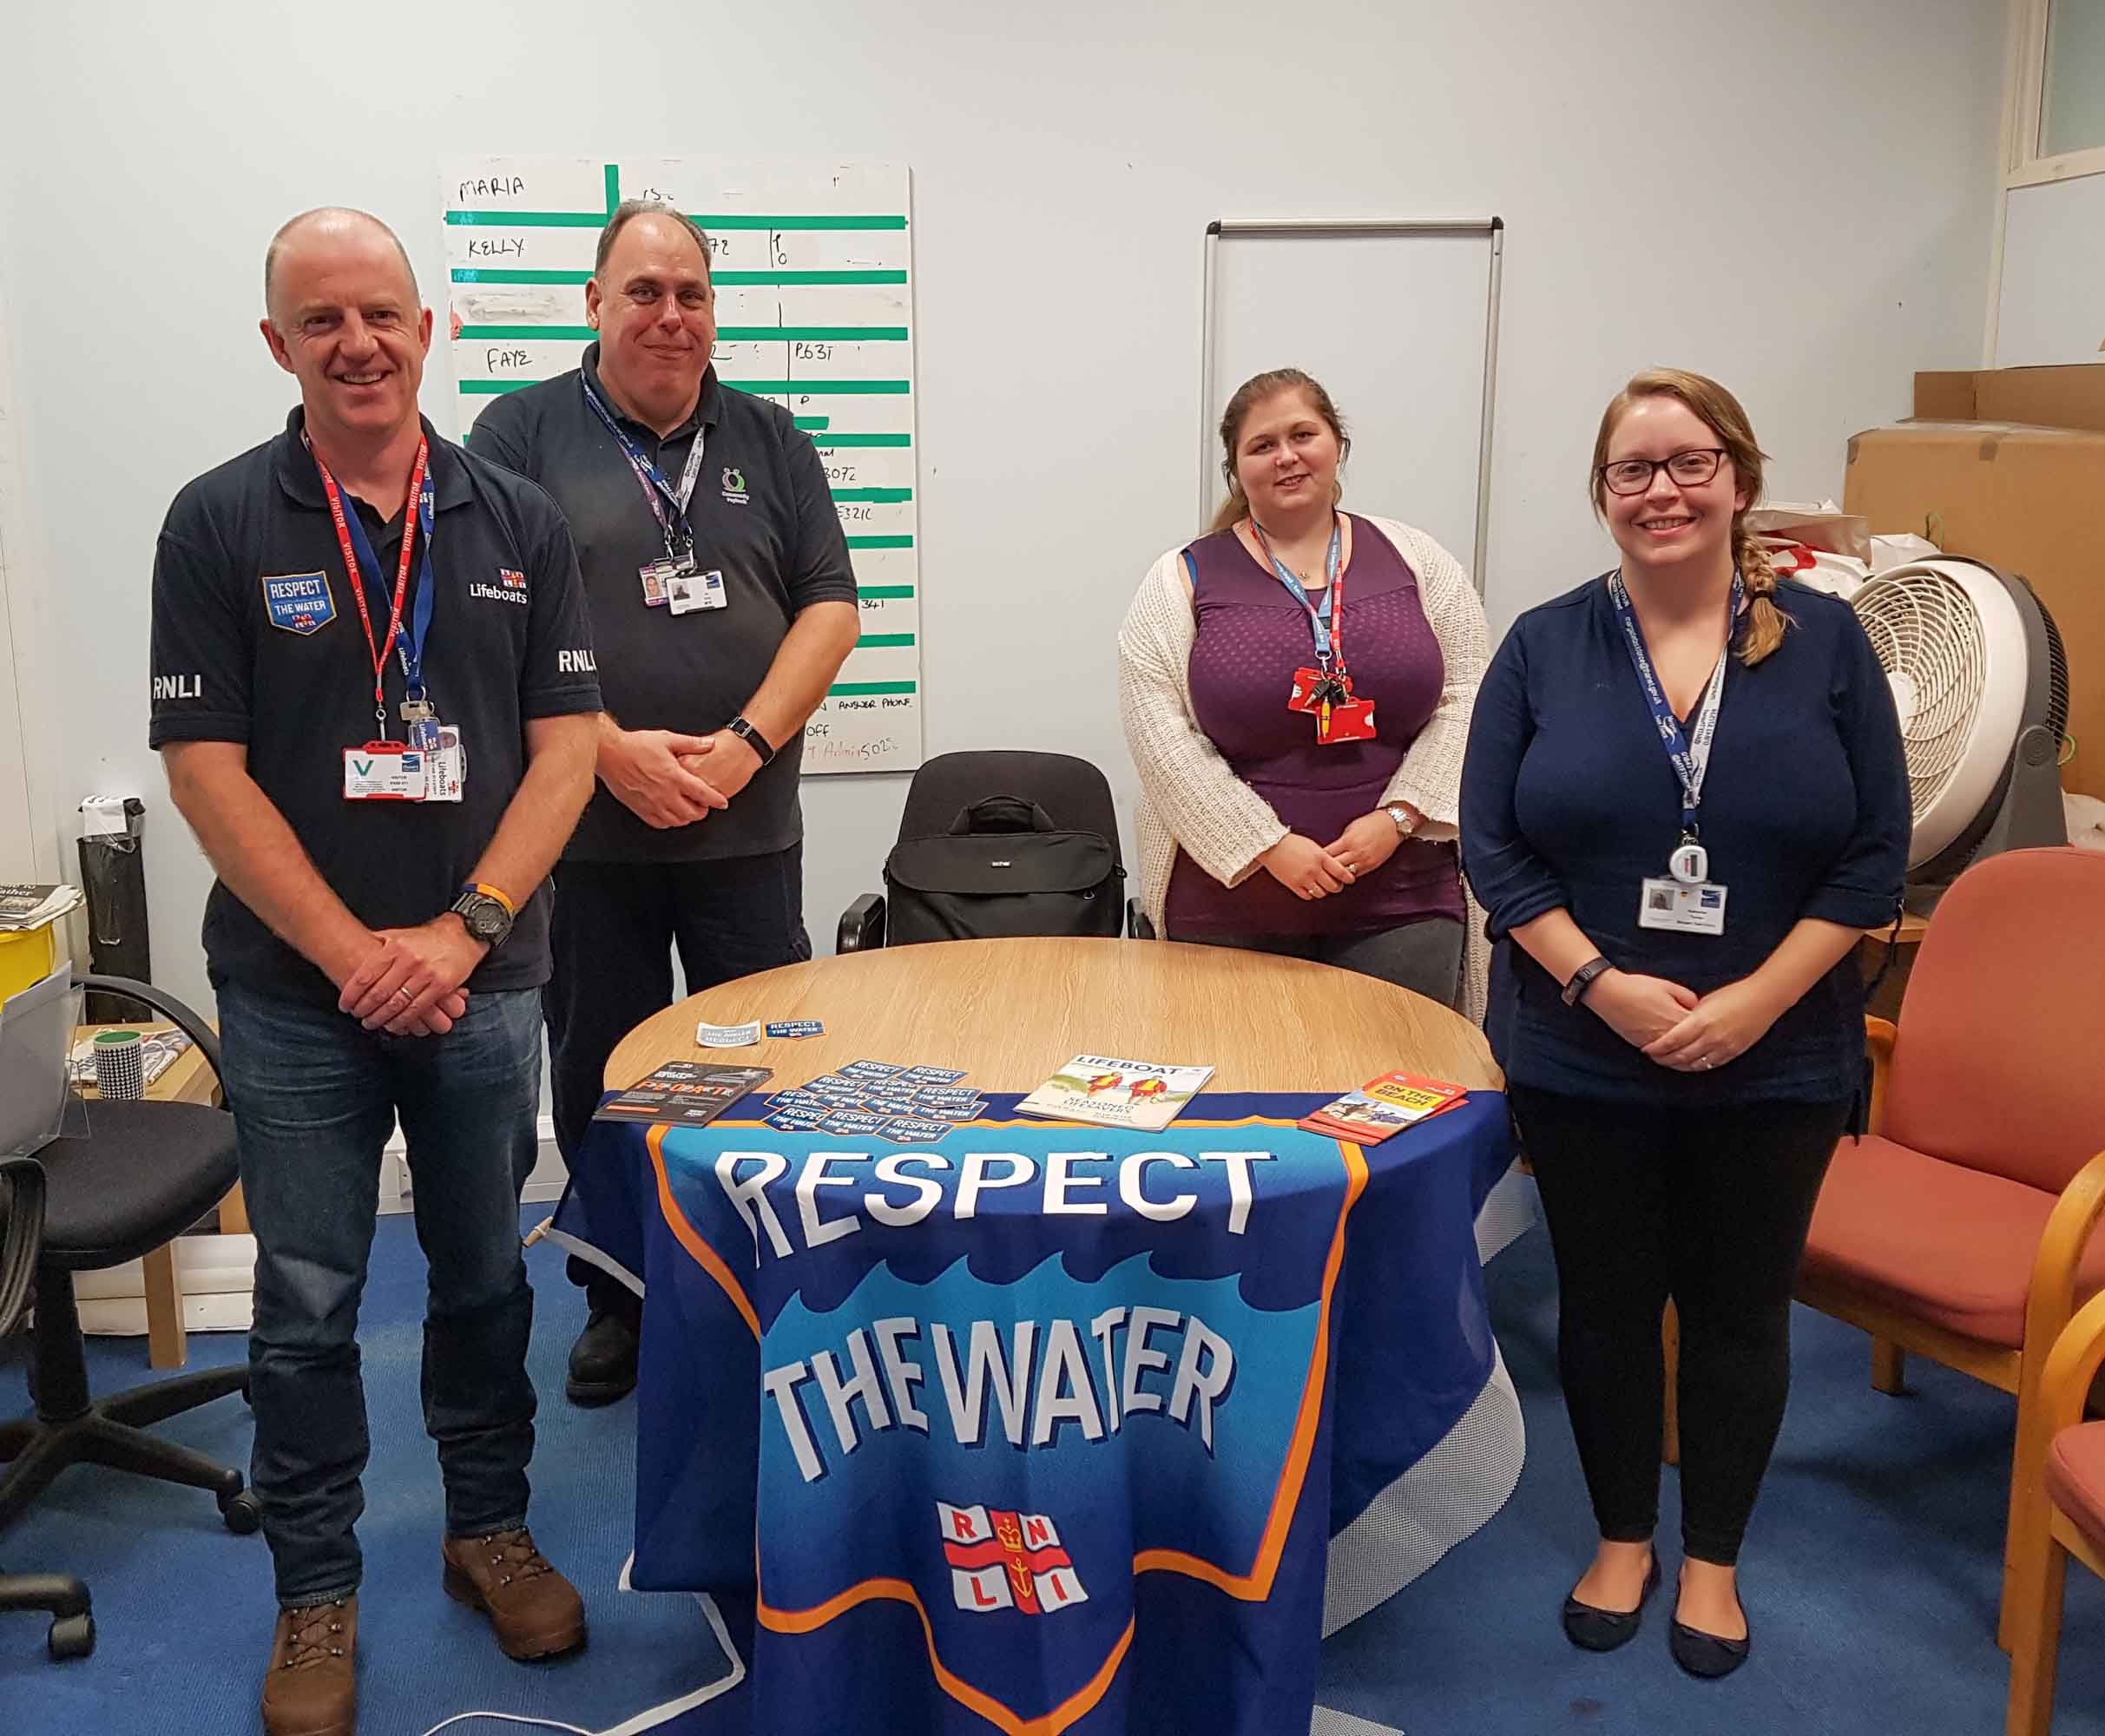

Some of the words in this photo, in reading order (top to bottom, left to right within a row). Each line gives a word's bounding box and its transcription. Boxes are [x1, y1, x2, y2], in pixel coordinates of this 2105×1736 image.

[459, 176, 524, 201] MARIA
[487, 348, 532, 373] FAYE
[409, 482, 420, 510] VISITOR
[332, 496, 346, 528] VISITOR
[403, 523, 414, 552] VISITOR
[343, 542, 358, 574] VISITOR
[270, 580, 320, 599] RESPECT
[470, 583, 527, 604] Lifeboats
[274, 603, 293, 615] THE
[295, 600, 326, 612] WATER
[153, 674, 201, 700] RNLI
[352, 760, 374, 776] V
[854, 1062, 901, 1074] RESPECT
[913, 1067, 963, 1078] RESPECT
[1077, 1056, 1185, 1075] LIFEBOAT
[923, 1087, 975, 1096] RESPECT
[1375, 1088, 1427, 1106] BEACH
[1383, 1085, 1404, 1094] ON
[1409, 1091, 1437, 1101] THE
[832, 1111, 885, 1125] RESPECT
[937, 1108, 970, 1117] WATER
[843, 1122, 875, 1132] WATER
[893, 1119, 946, 1132] RESPECT
[904, 1130, 937, 1140] WATER
[714, 1151, 1273, 1270] RESPECT
[762, 1317, 929, 1483] THE
[930, 1305, 1234, 1451] WATER
[951, 1510, 977, 1539] R
[1027, 1519, 1049, 1545] N
[970, 1576, 997, 1607] L
